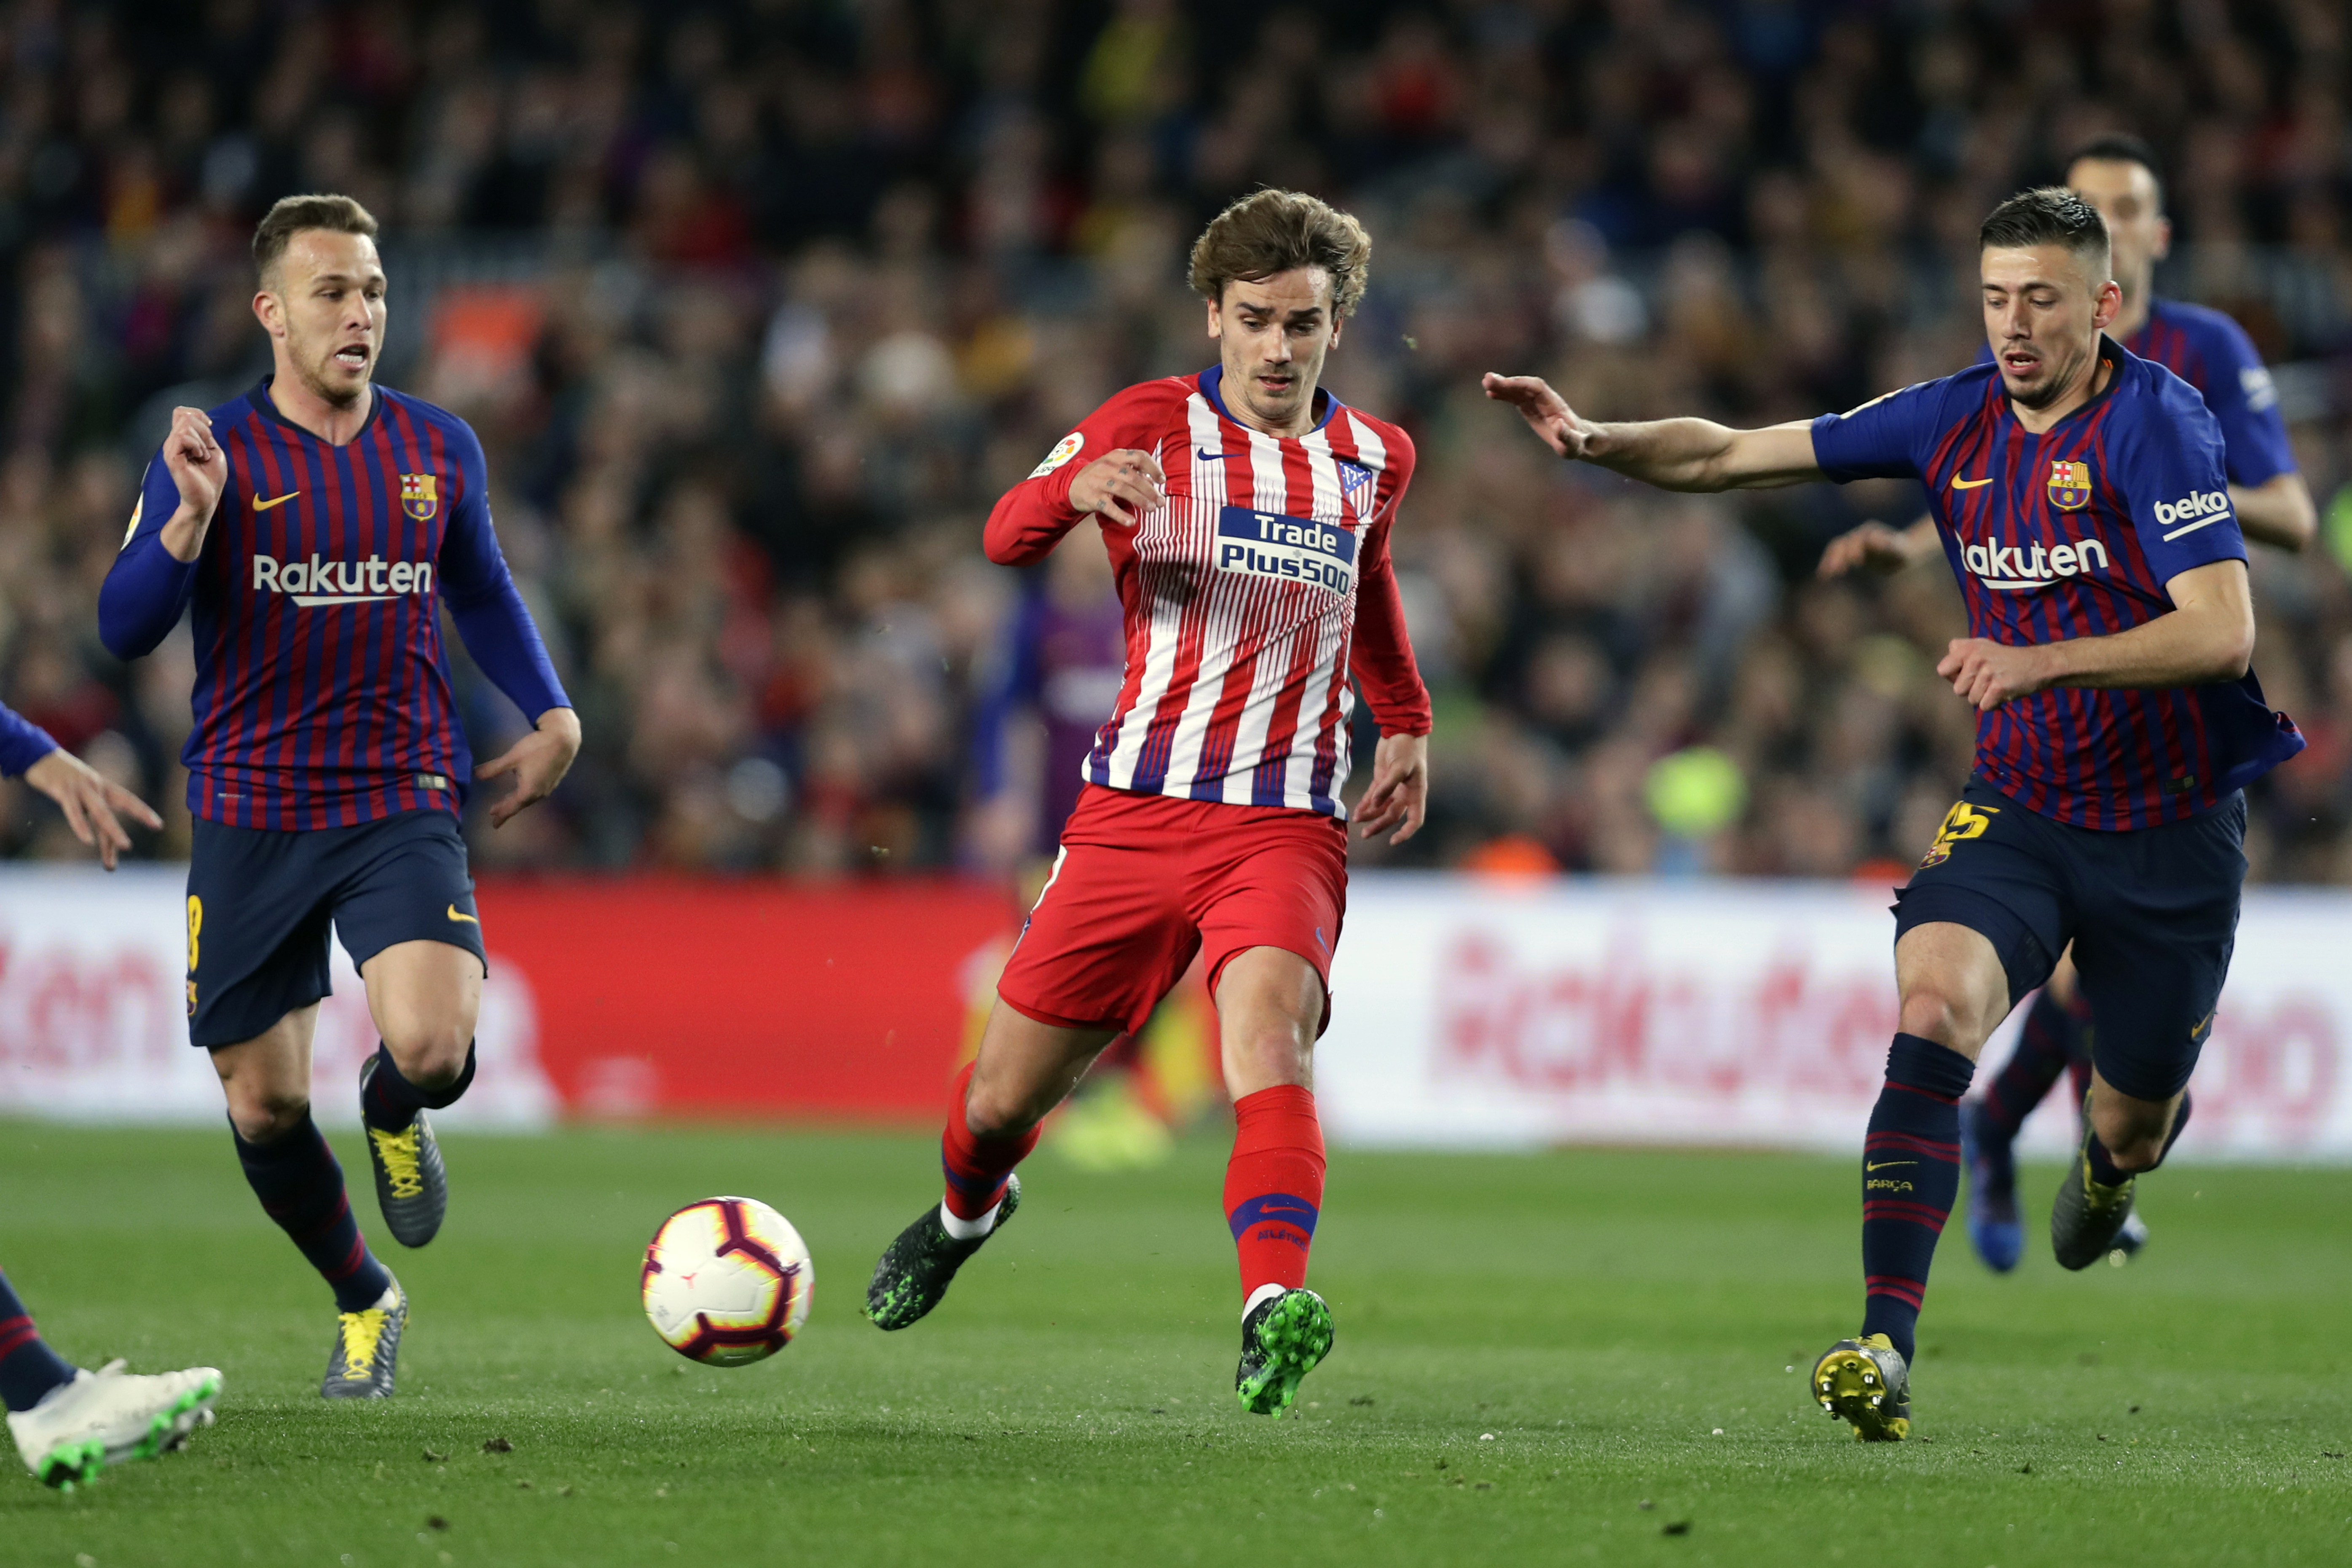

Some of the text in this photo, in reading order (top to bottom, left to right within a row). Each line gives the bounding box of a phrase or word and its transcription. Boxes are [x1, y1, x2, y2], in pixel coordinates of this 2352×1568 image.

[2154, 490, 2228, 525] beko
[1254, 514, 1337, 554] Trade
[253, 553, 432, 593] Rakuten
[1220, 543, 1349, 595] Plus500
[1867, 1179, 1913, 1192] BARÇA
[1257, 1229, 1306, 1252] ATLÉTICO
